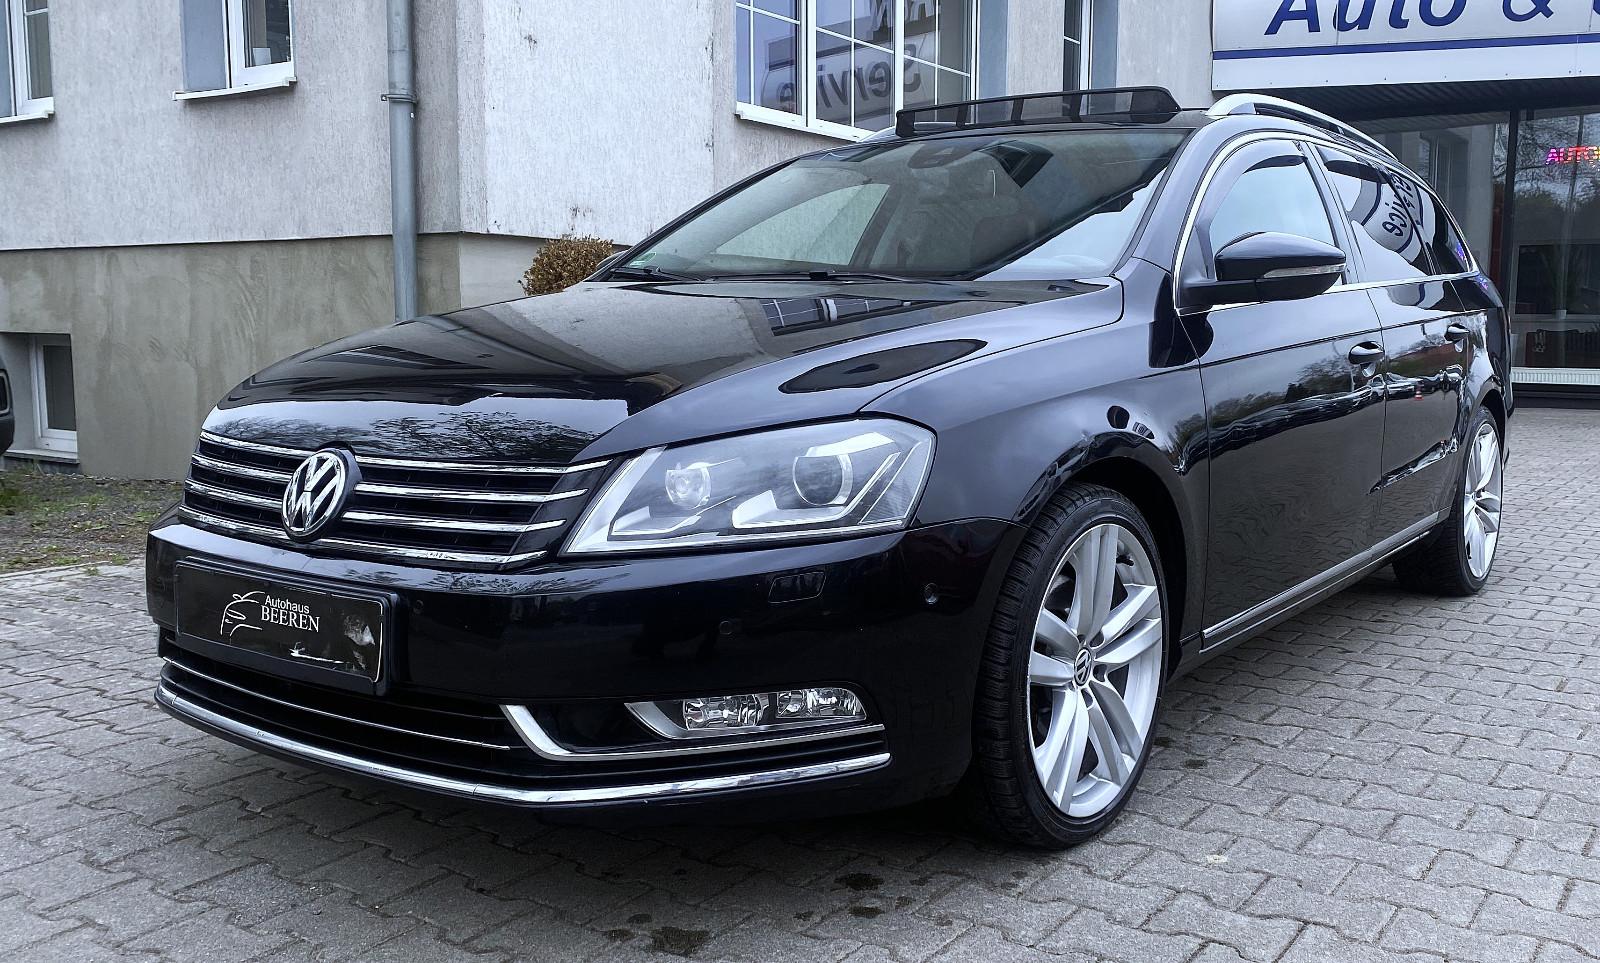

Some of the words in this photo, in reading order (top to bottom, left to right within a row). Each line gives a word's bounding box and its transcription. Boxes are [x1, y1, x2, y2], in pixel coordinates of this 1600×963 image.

[1264, 0, 1466, 35] Auto
[1545, 146, 1600, 164] AUTO
[265, 595, 310, 614] Autohaus
[261, 605, 320, 632] BEEREN
